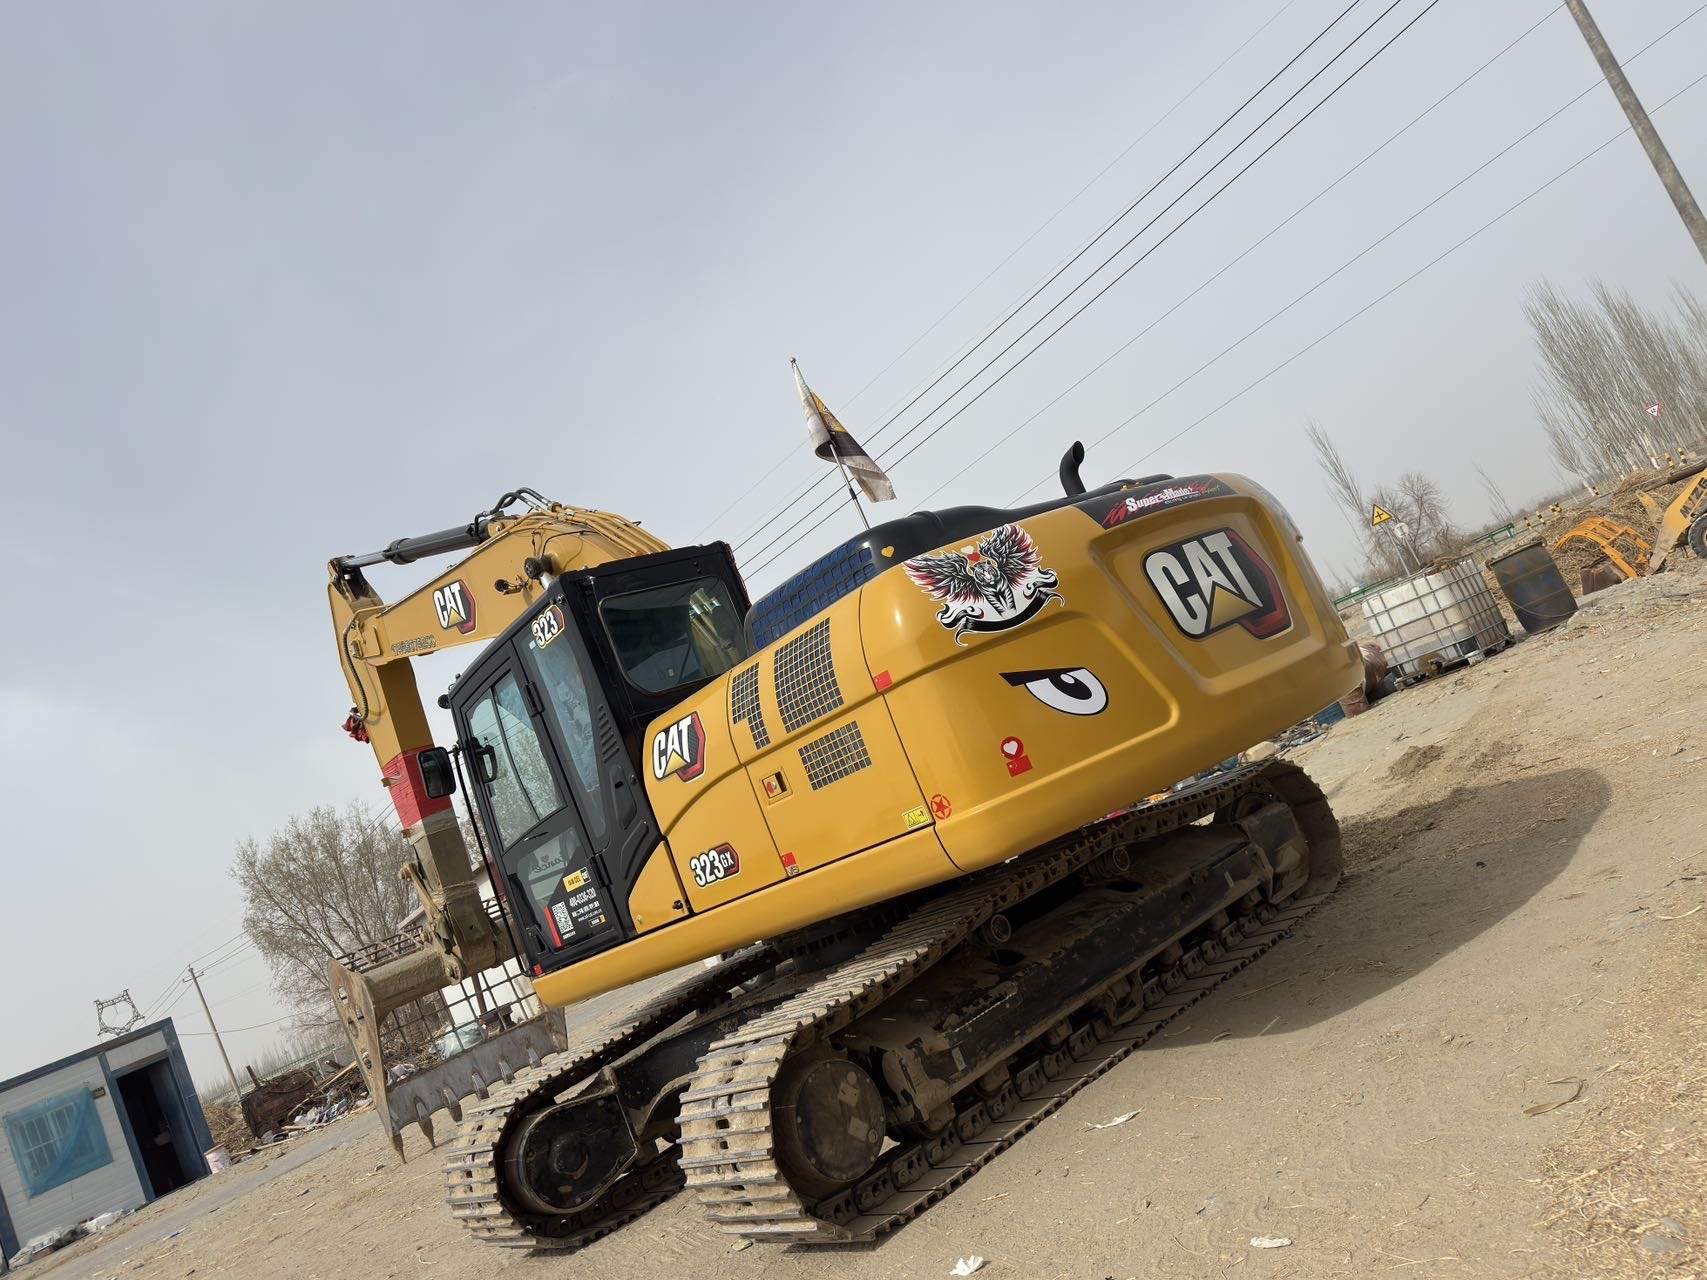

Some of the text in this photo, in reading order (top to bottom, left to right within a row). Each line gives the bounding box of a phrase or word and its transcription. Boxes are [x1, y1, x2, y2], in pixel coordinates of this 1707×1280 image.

[434, 581, 467, 628] CAT
[1146, 531, 1264, 635] CAT
[532, 610, 559, 646] 323
[653, 715, 692, 779] CAT
